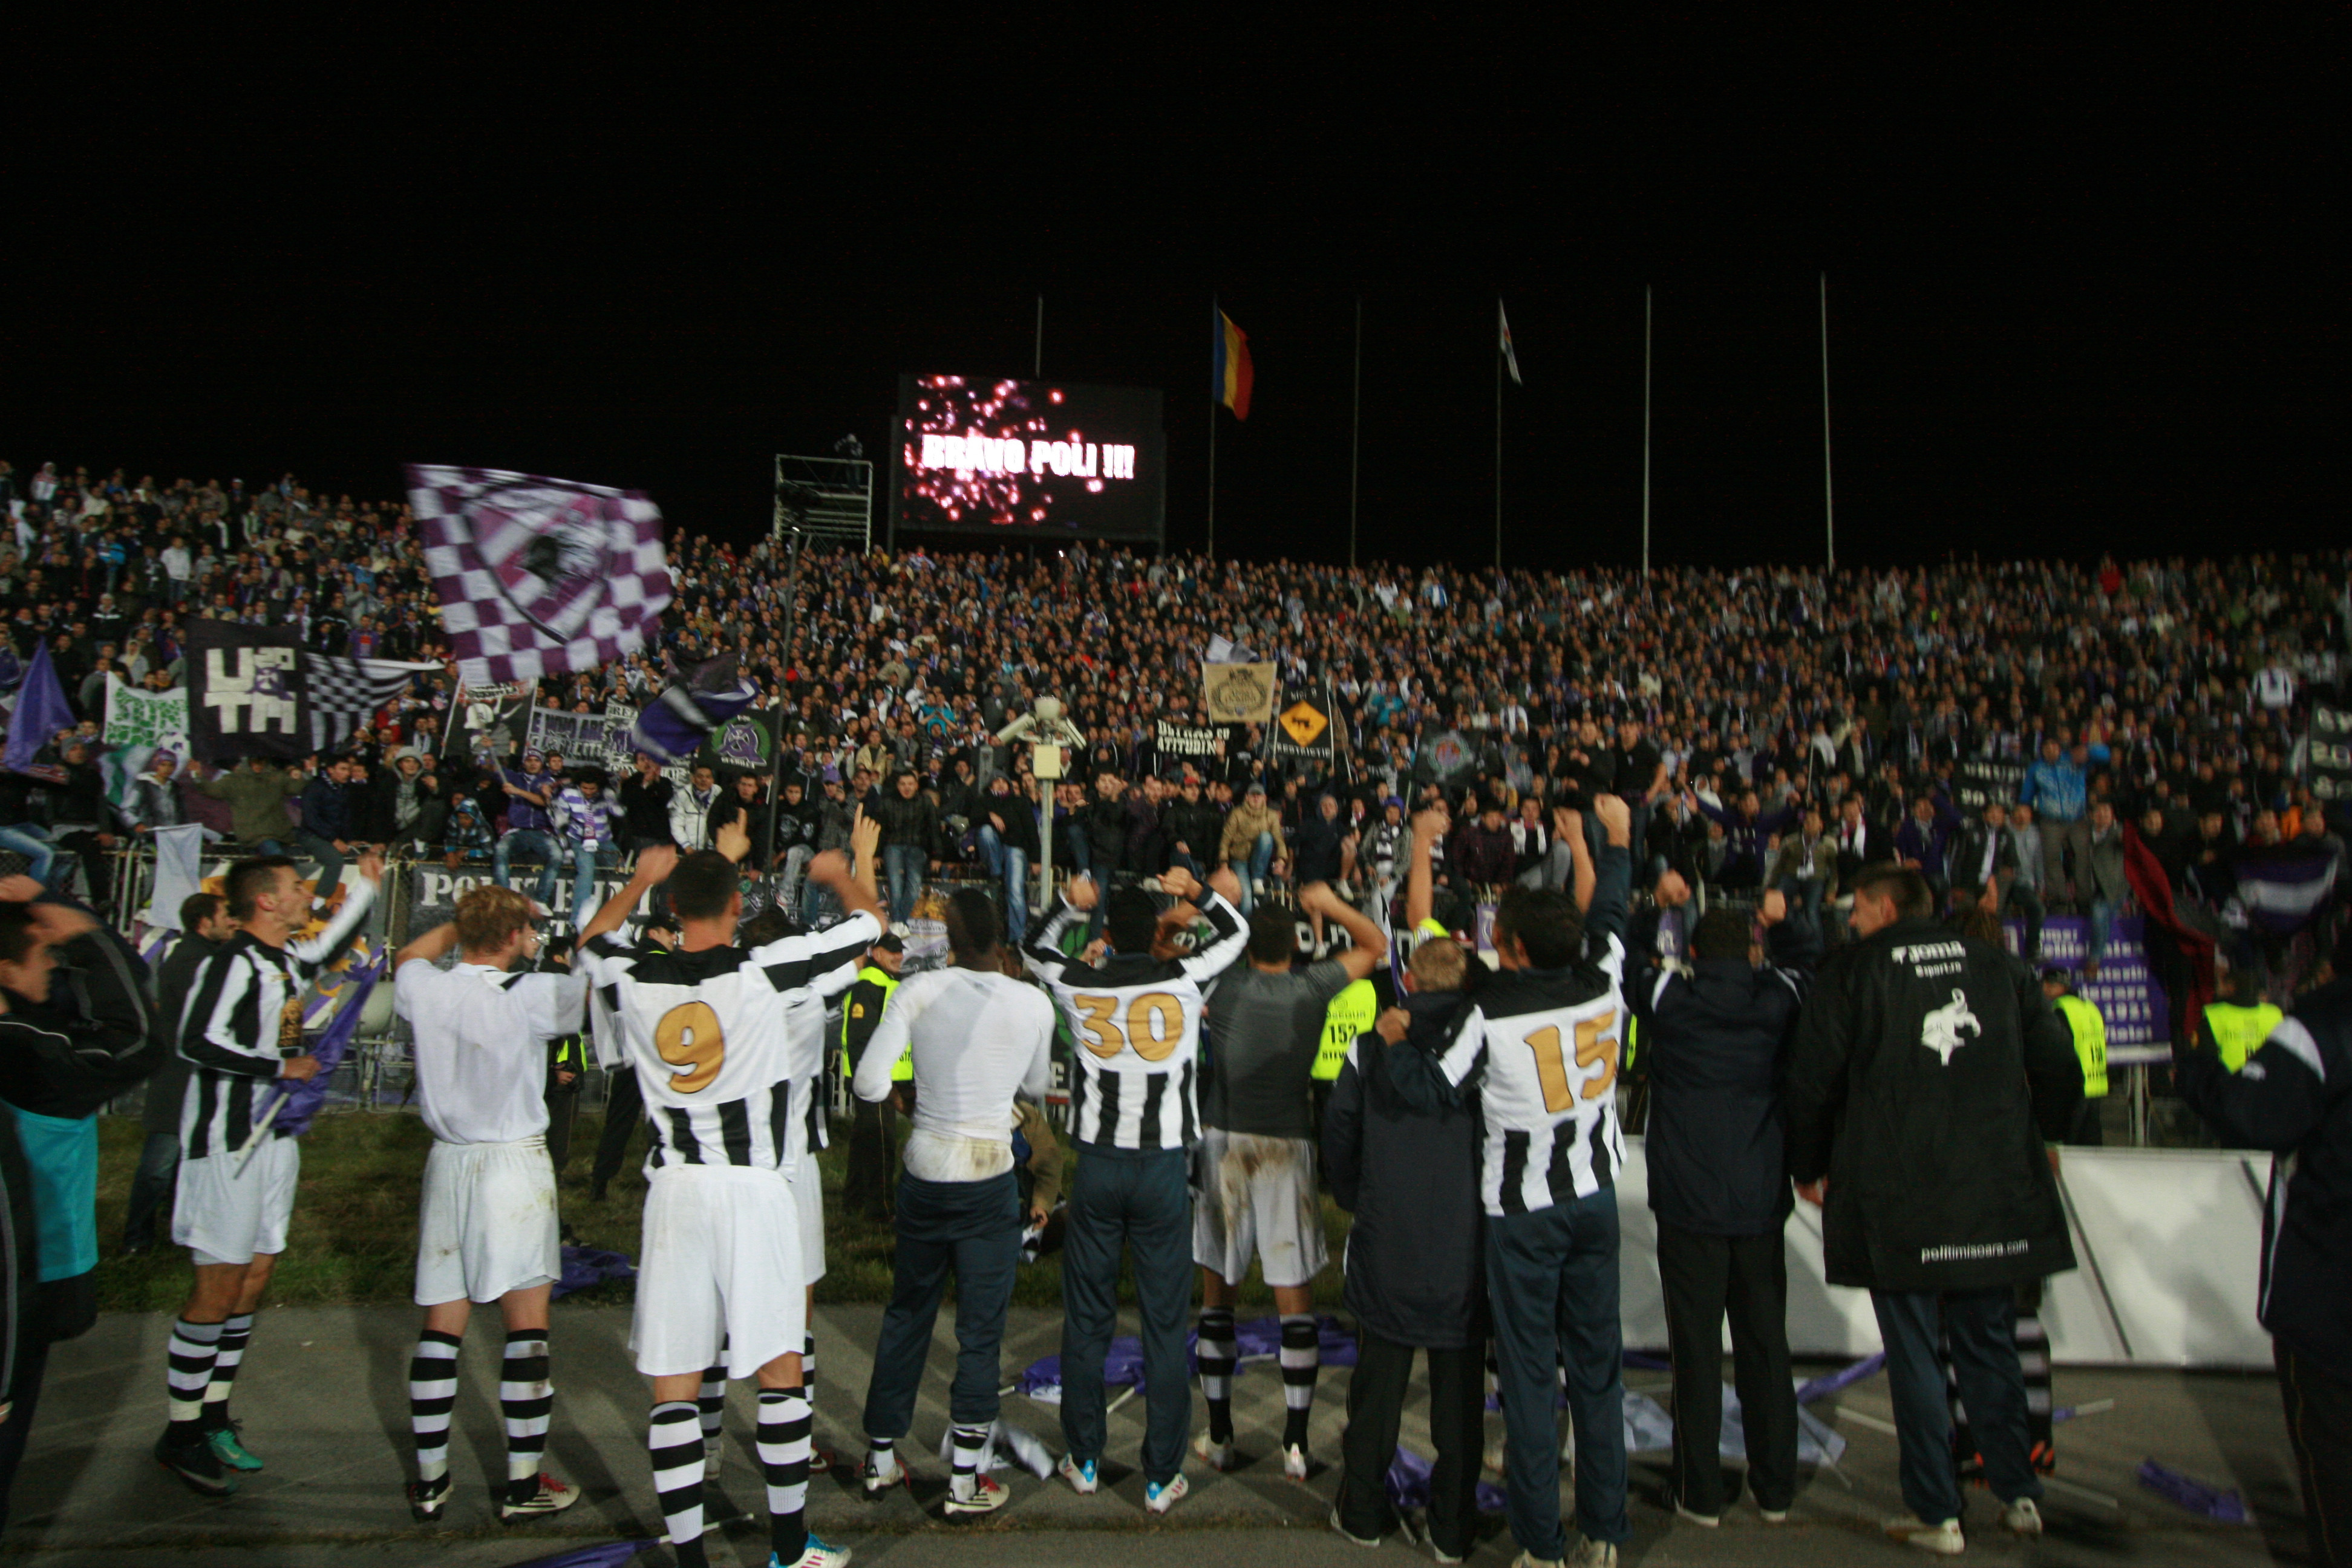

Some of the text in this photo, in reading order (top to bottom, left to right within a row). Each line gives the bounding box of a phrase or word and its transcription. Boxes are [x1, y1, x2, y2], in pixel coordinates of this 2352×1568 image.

[922, 434, 1025, 473] BRAVO
[1031, 441, 1097, 477] POLI
[1157, 736, 1218, 756] ATITUDIN
[655, 1000, 724, 1094] 9
[1073, 992, 1184, 1062] 30
[1523, 1008, 1620, 1114] 15
